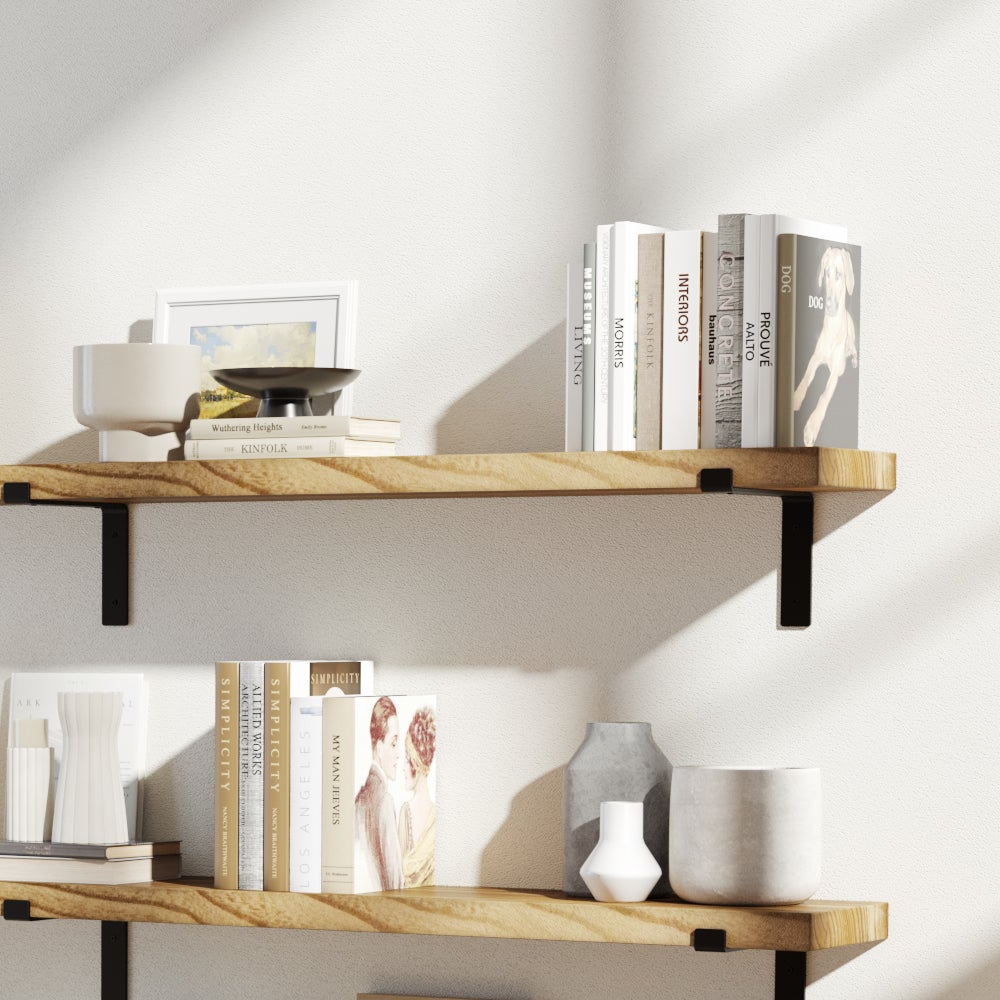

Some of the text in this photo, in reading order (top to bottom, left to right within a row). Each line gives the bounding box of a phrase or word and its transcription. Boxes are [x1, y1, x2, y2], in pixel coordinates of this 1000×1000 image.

[583, 267, 592, 345] MUSEUMS
[678, 273, 689, 342] INTERIORS
[781, 265, 792, 294] DOG
[808, 295, 823, 309] DOG
[615, 318, 624, 368] MORRIS
[646, 312, 654, 369] KINFOLK
[708, 315, 717, 365] bauhaus
[717, 252, 735, 400] CONCRETE
[745, 322, 755, 361] AALTO
[760, 312, 773, 367] PROUVÉ
[573, 326, 583, 386] LIVING
[211, 422, 283, 434] Wuthering Heights
[241, 444, 288, 454] KINFOLK
[17, 699, 41, 707] ARK
[310, 672, 360, 684] SIMPLICITY
[220, 678, 231, 791] SIMPLICITY
[252, 684, 262, 776] ALLIED WORKS
[270, 678, 281, 793] SIMPLICITY
[332, 735, 340, 825] MY MAN JEEVES
[300, 730, 311, 888] LOS ANGELES
